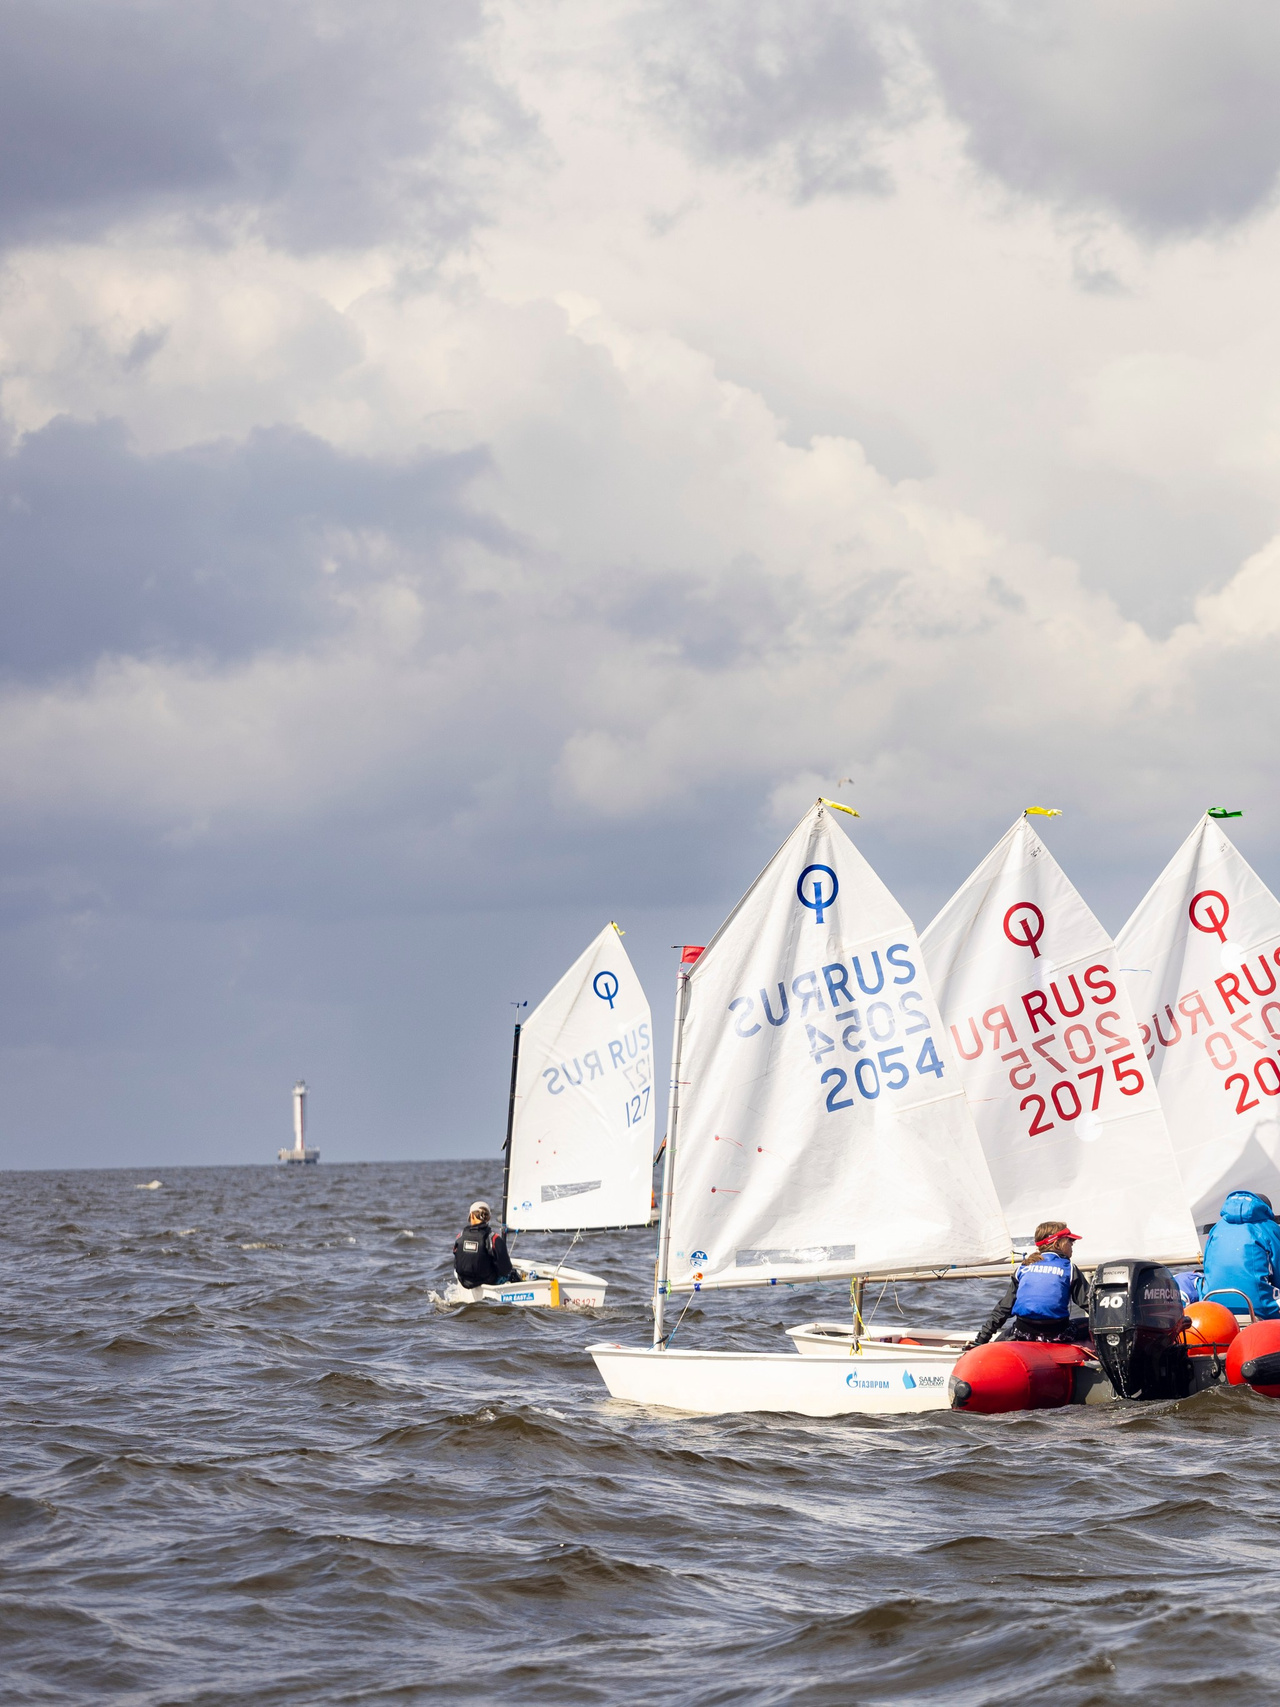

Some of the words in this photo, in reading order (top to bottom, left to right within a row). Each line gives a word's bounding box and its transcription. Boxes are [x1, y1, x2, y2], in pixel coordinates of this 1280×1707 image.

[822, 943, 916, 1007] RUS
[1021, 965, 1117, 1033] RUS
[607, 1023, 650, 1071] RUS
[820, 1036, 945, 1113] 2054
[1019, 1052, 1145, 1137] 2075
[625, 1086, 651, 1128] 127
[1030, 1265, 1065, 1277] ГАЗПРОМ
[1099, 1296, 1124, 1309] 40
[1143, 1288, 1180, 1300] MERCUR
[858, 1380, 890, 1389] ГАЗПРОМ
